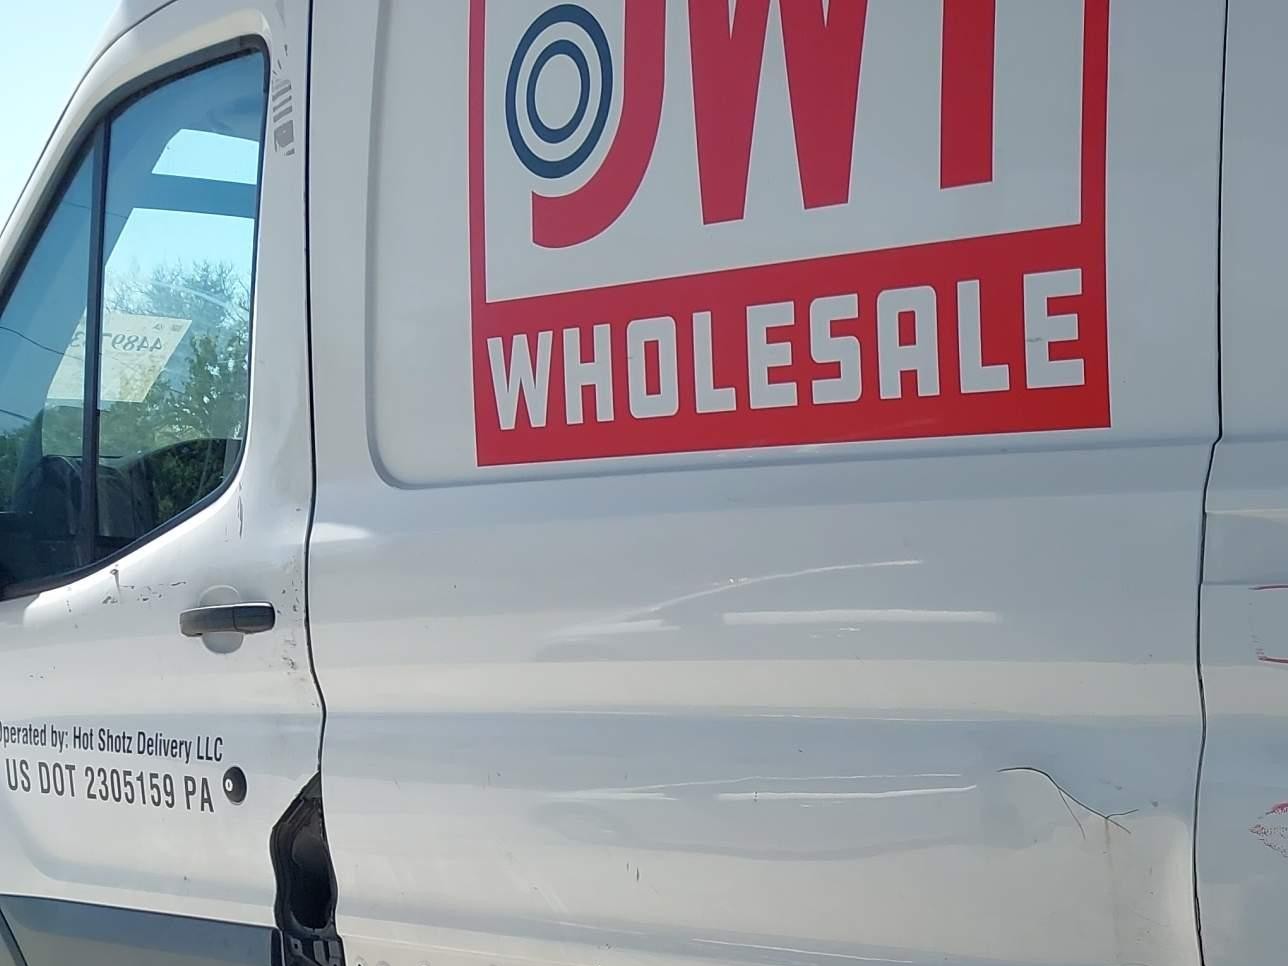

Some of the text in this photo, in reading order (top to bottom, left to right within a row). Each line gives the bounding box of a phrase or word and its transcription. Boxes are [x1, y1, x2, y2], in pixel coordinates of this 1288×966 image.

[487, 268, 1085, 430] WHOLESALE
[51, 725, 69, 753] by:
[73, 726, 94, 751] Hot
[98, 728, 132, 754] Shotz
[137, 731, 192, 764] Delivery
[197, 736, 223, 762] LLC
[6, 759, 214, 813] US DOT 2305159 PA
